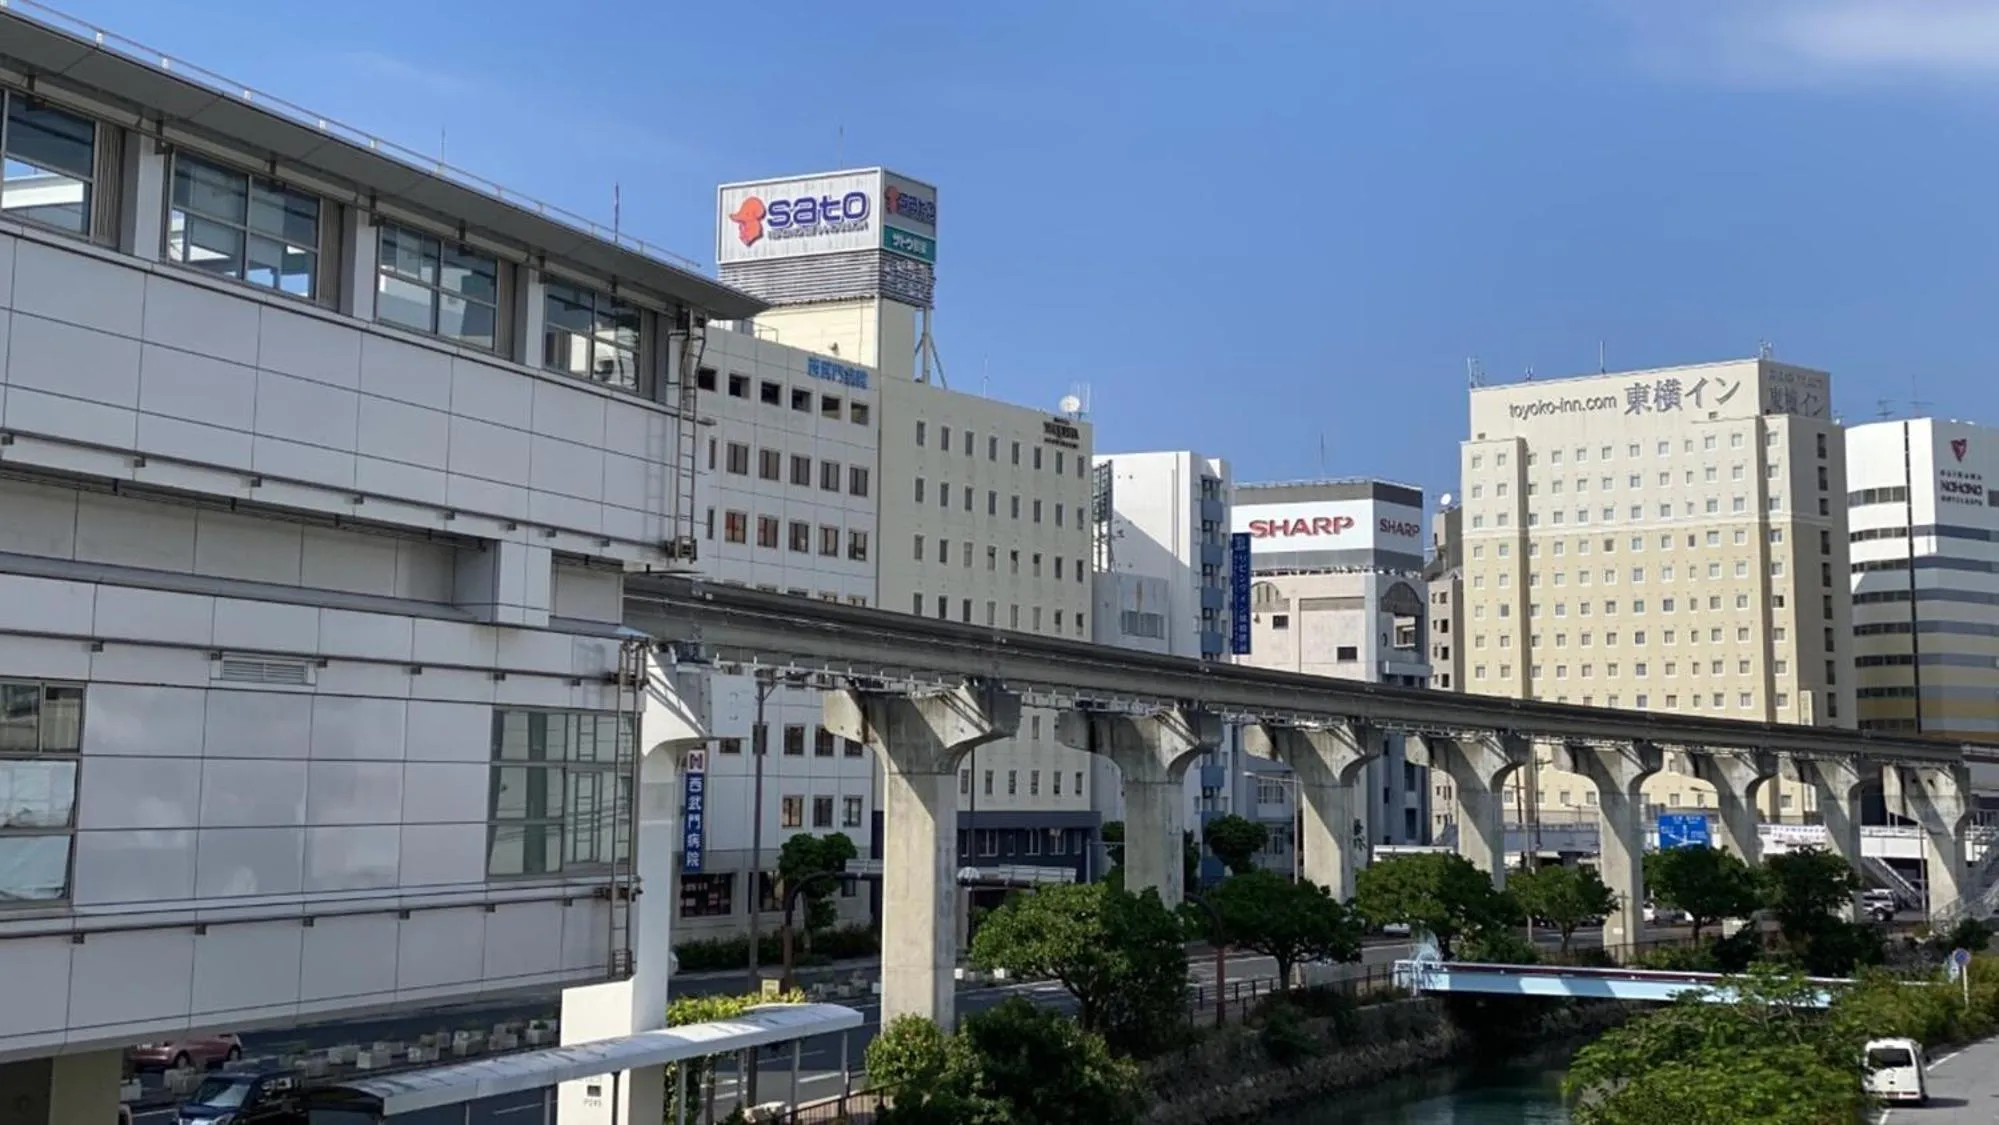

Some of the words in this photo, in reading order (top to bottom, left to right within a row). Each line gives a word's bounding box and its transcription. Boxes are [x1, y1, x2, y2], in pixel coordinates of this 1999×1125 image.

[767, 191, 870, 227] sato
[1509, 395, 1617, 420] toyoko-inn.com
[1623, 377, 1741, 415] 東横イン
[1248, 516, 1355, 538] SHARP
[1379, 517, 1420, 538] SHARP
[687, 777, 702, 867] 西武門病院
